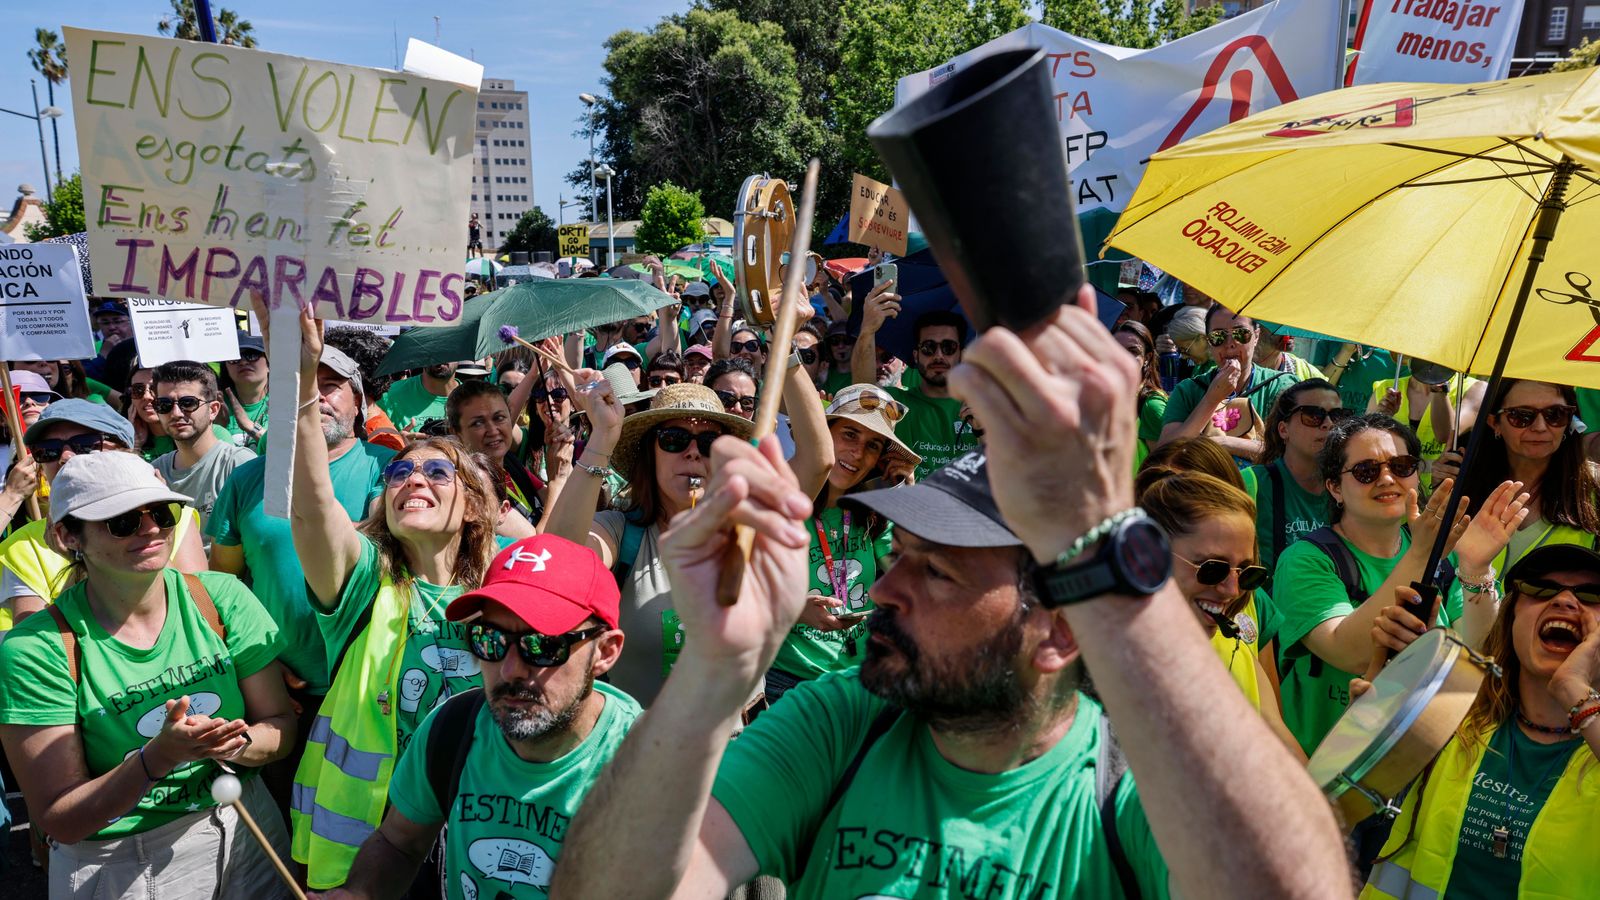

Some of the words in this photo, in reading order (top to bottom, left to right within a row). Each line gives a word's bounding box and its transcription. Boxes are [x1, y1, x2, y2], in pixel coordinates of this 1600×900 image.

[1396, 32, 1493, 68] menos,
[86, 39, 232, 122] ENS
[266, 62, 462, 155] VOLEN
[1066, 131, 1108, 164] FP
[860, 186, 889, 206] EDUCAR
[1070, 174, 1118, 204] AT
[97, 184, 191, 233] Ens
[204, 183, 307, 245] han
[874, 208, 884, 218] NO
[560, 226, 587, 237] ORTI
[562, 244, 589, 255] HOME
[108, 239, 464, 323] IMPARABLES
[107, 653, 227, 715] ESTIMEM
[1466, 805, 1479, 813] ue
[1479, 808, 1501, 820] posa
[1513, 819, 1530, 828] cor
[1467, 816, 1488, 828] cada
[1463, 826, 1480, 837] que
